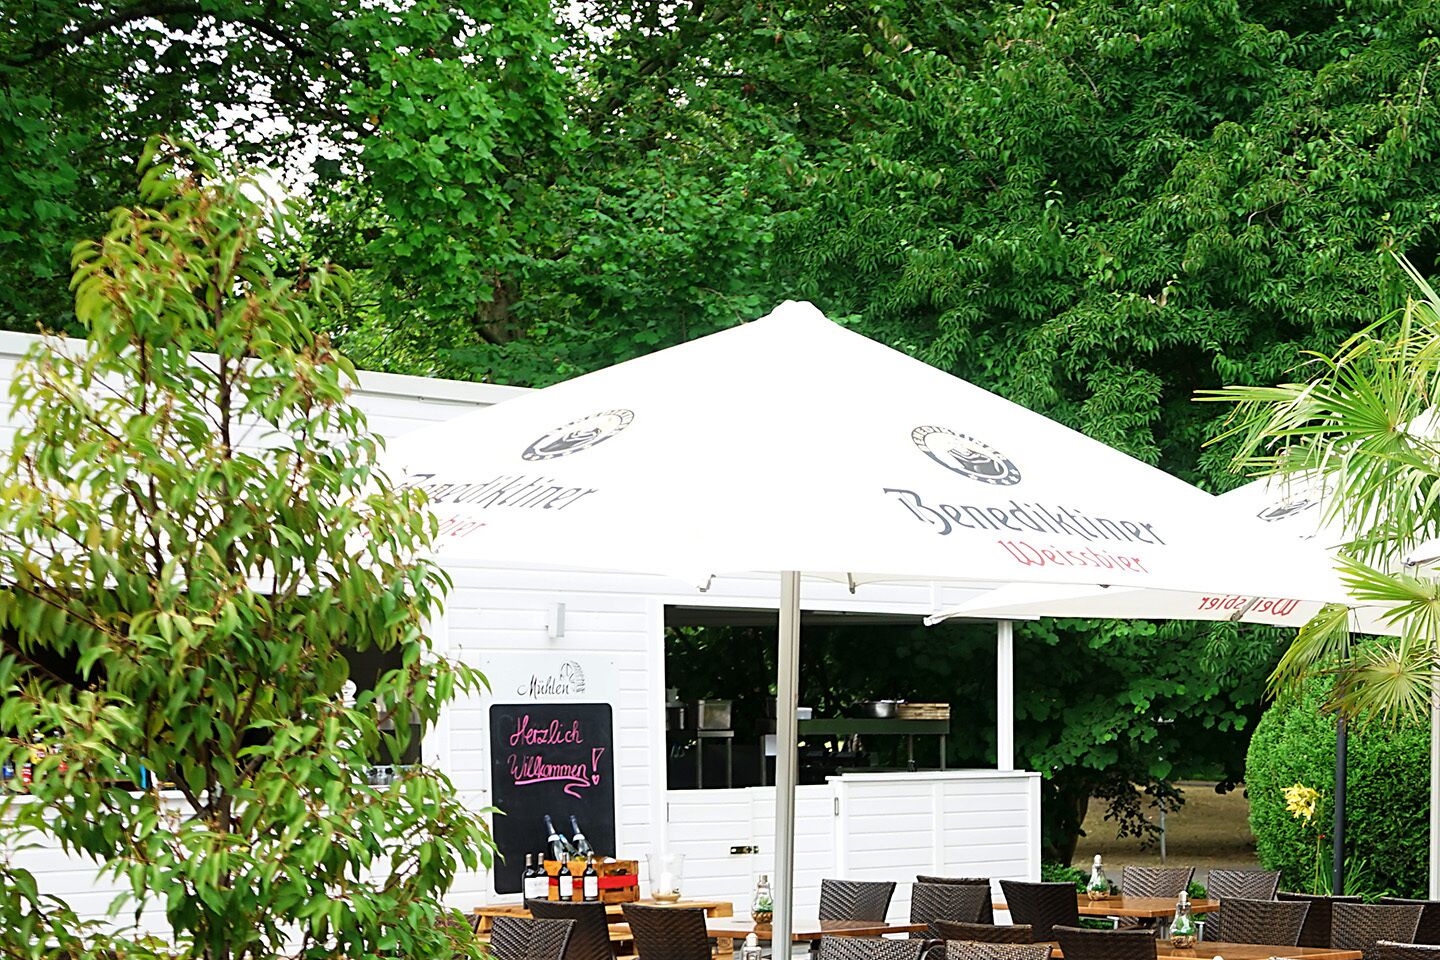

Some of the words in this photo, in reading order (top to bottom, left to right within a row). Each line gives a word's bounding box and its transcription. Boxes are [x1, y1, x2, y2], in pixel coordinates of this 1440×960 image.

[883, 487, 1167, 546] Benediktiner
[996, 540, 1149, 574] Weissbier
[509, 714, 585, 746] Herzlich
